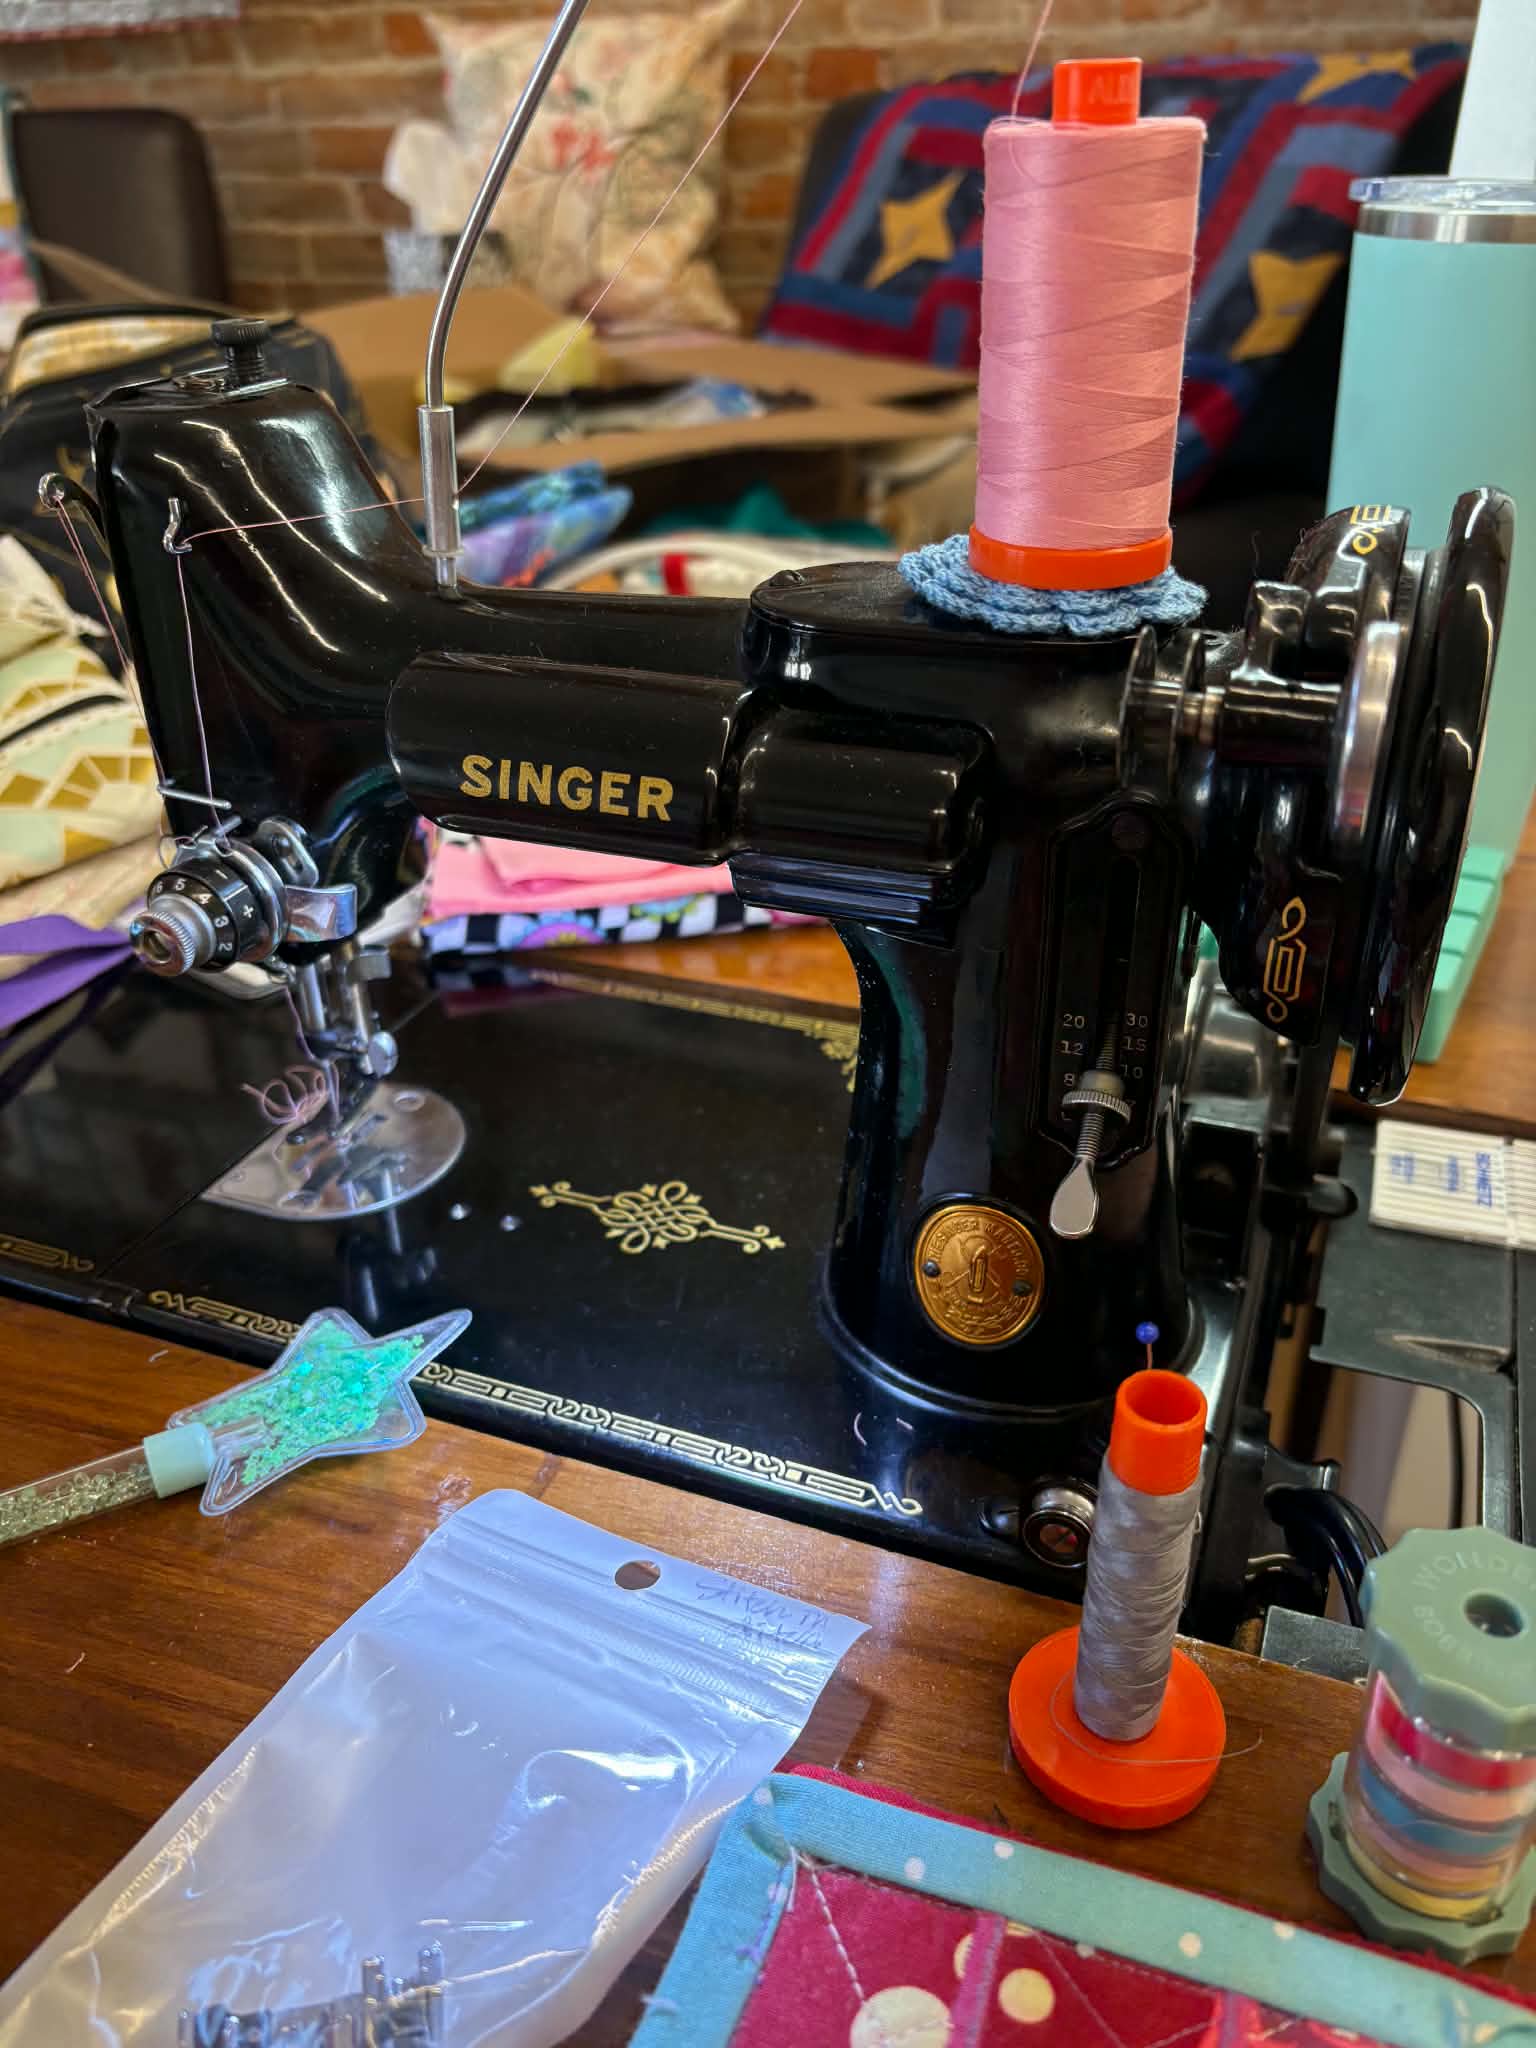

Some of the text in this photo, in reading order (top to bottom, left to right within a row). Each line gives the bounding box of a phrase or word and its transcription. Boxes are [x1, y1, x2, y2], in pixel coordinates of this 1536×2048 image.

[460, 754, 674, 822] SINGER
[175, 878, 187, 891] 5
[198, 893, 211, 905] 4
[215, 915, 229, 928] 3
[219, 942, 233, 951] 2
[1063, 1013, 1085, 1029] 20
[1127, 1012, 1148, 1028] 30
[1061, 1040, 1084, 1056] 12
